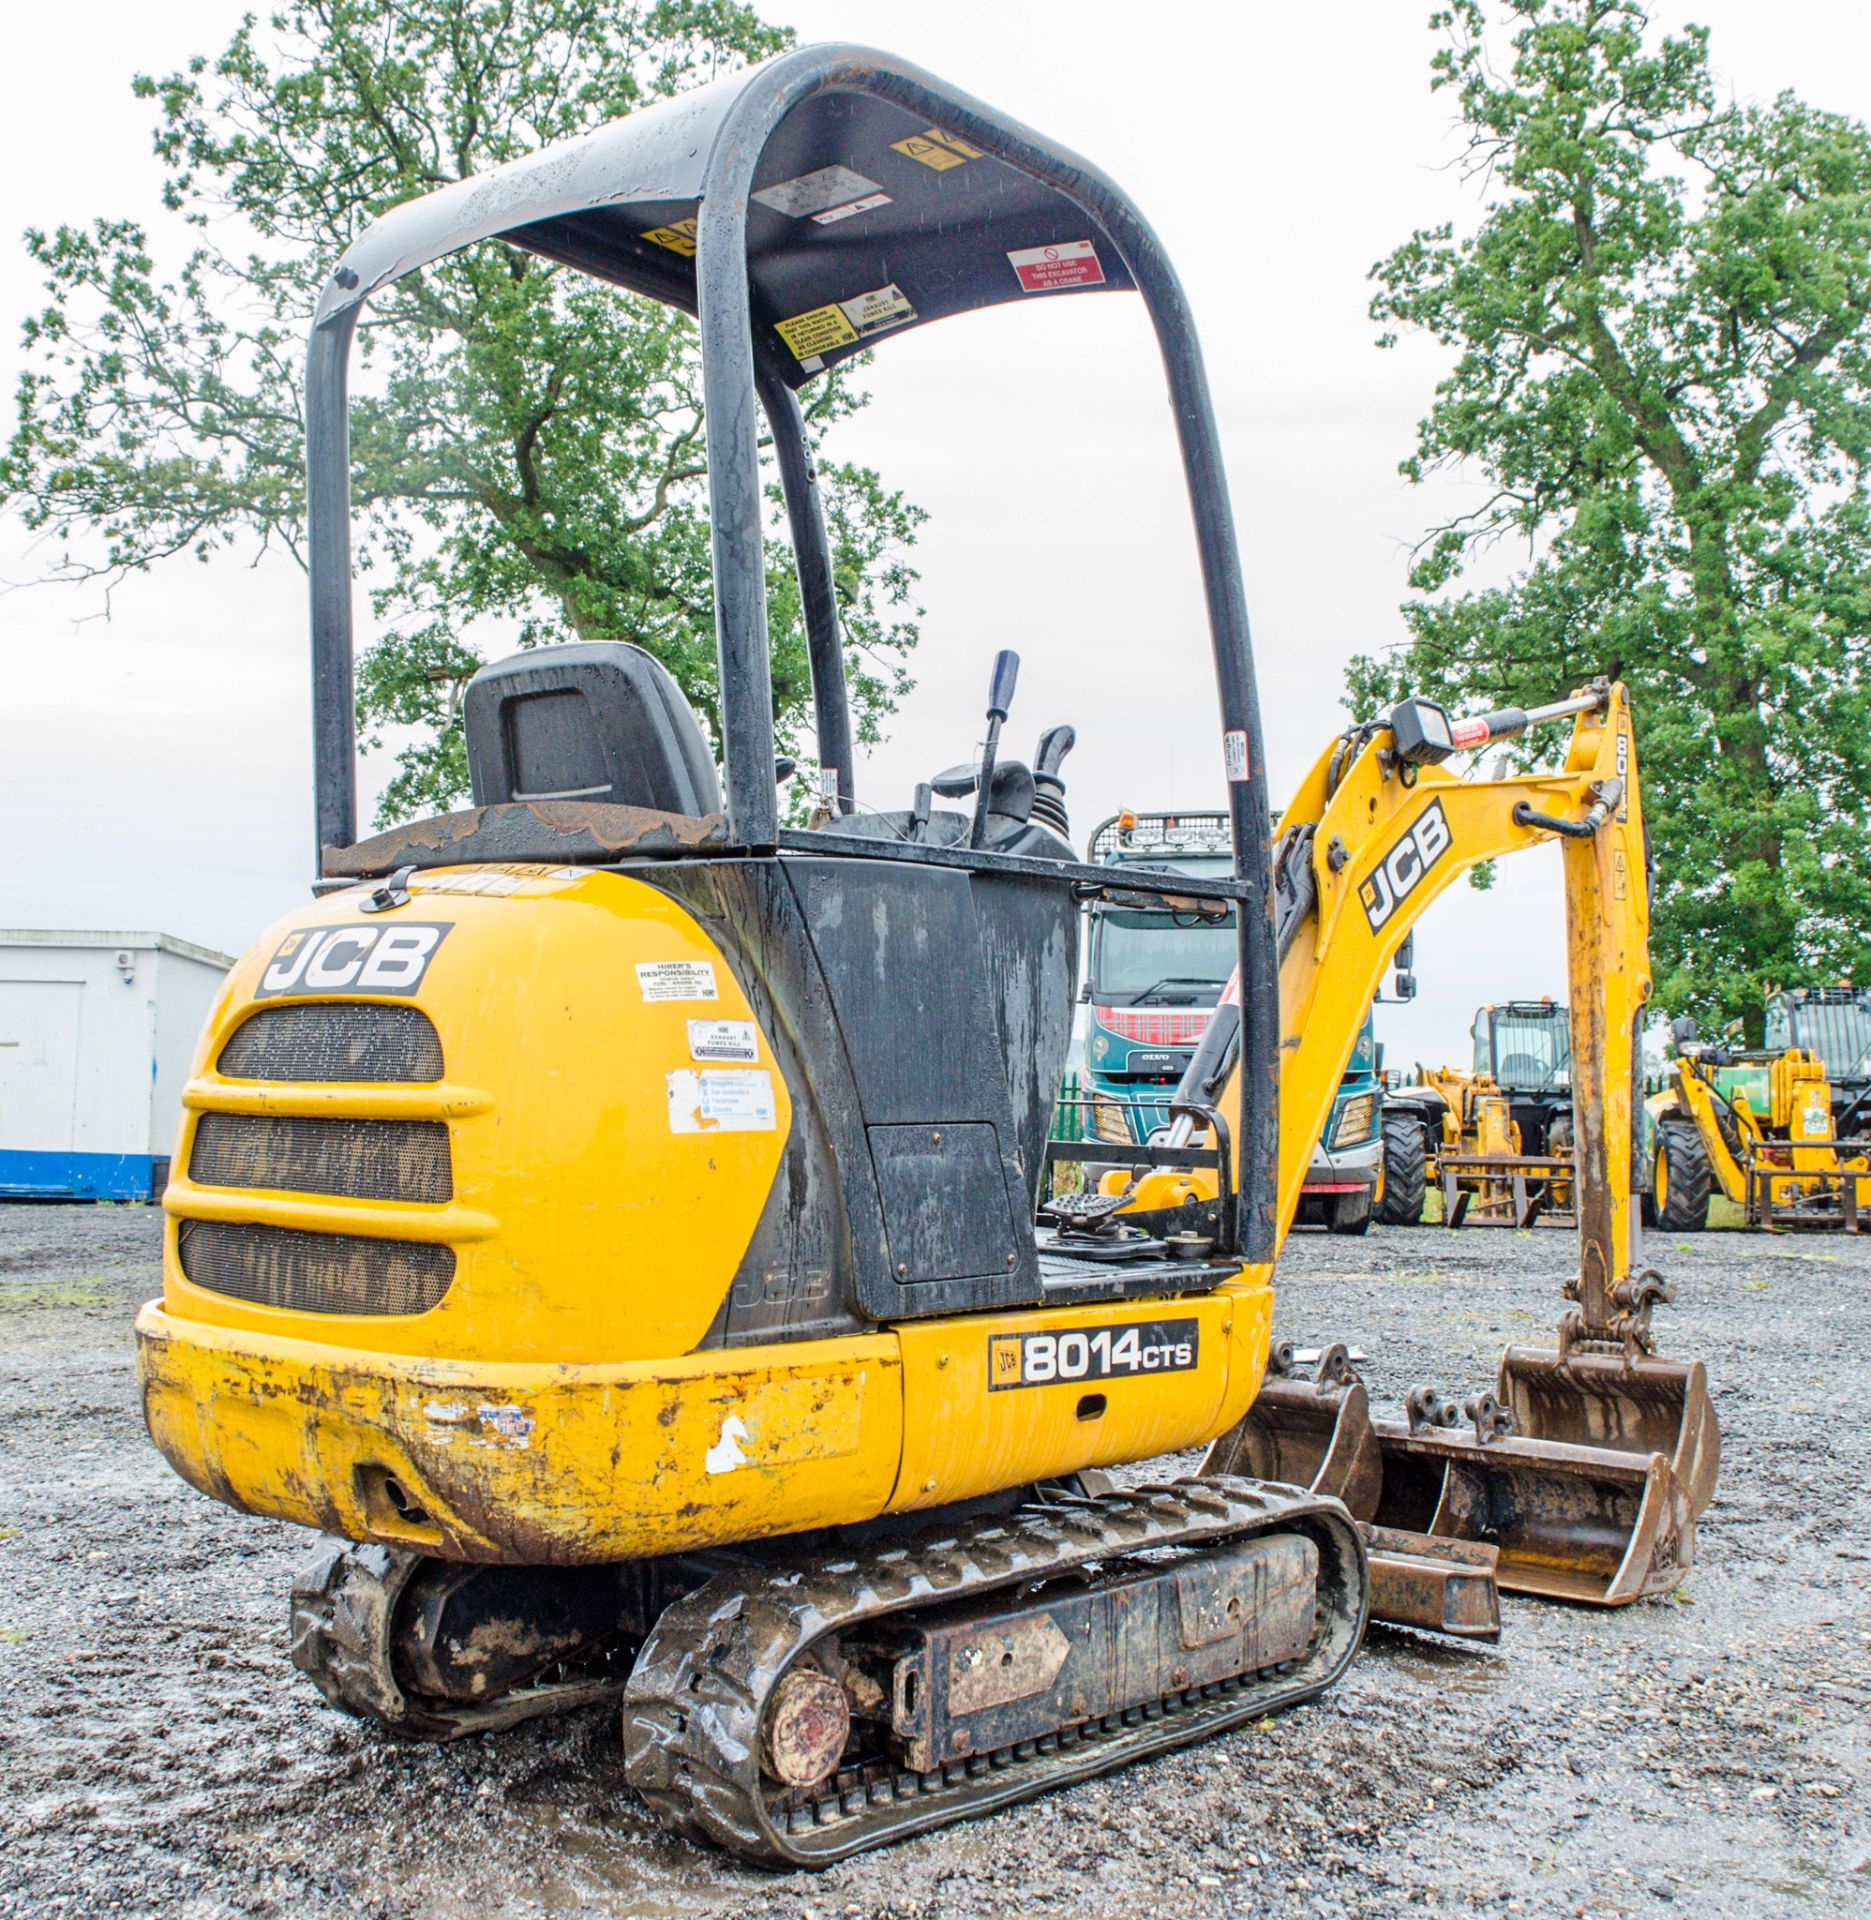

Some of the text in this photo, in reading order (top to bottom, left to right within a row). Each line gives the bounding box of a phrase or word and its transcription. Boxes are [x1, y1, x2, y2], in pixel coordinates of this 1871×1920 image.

[1048, 267, 1088, 277] EXCAVATOR
[1368, 805, 1449, 927] JCB
[264, 926, 440, 990] JCB
[640, 969, 710, 978] RESPONSIBILITY
[999, 1351, 1016, 1372] JCB
